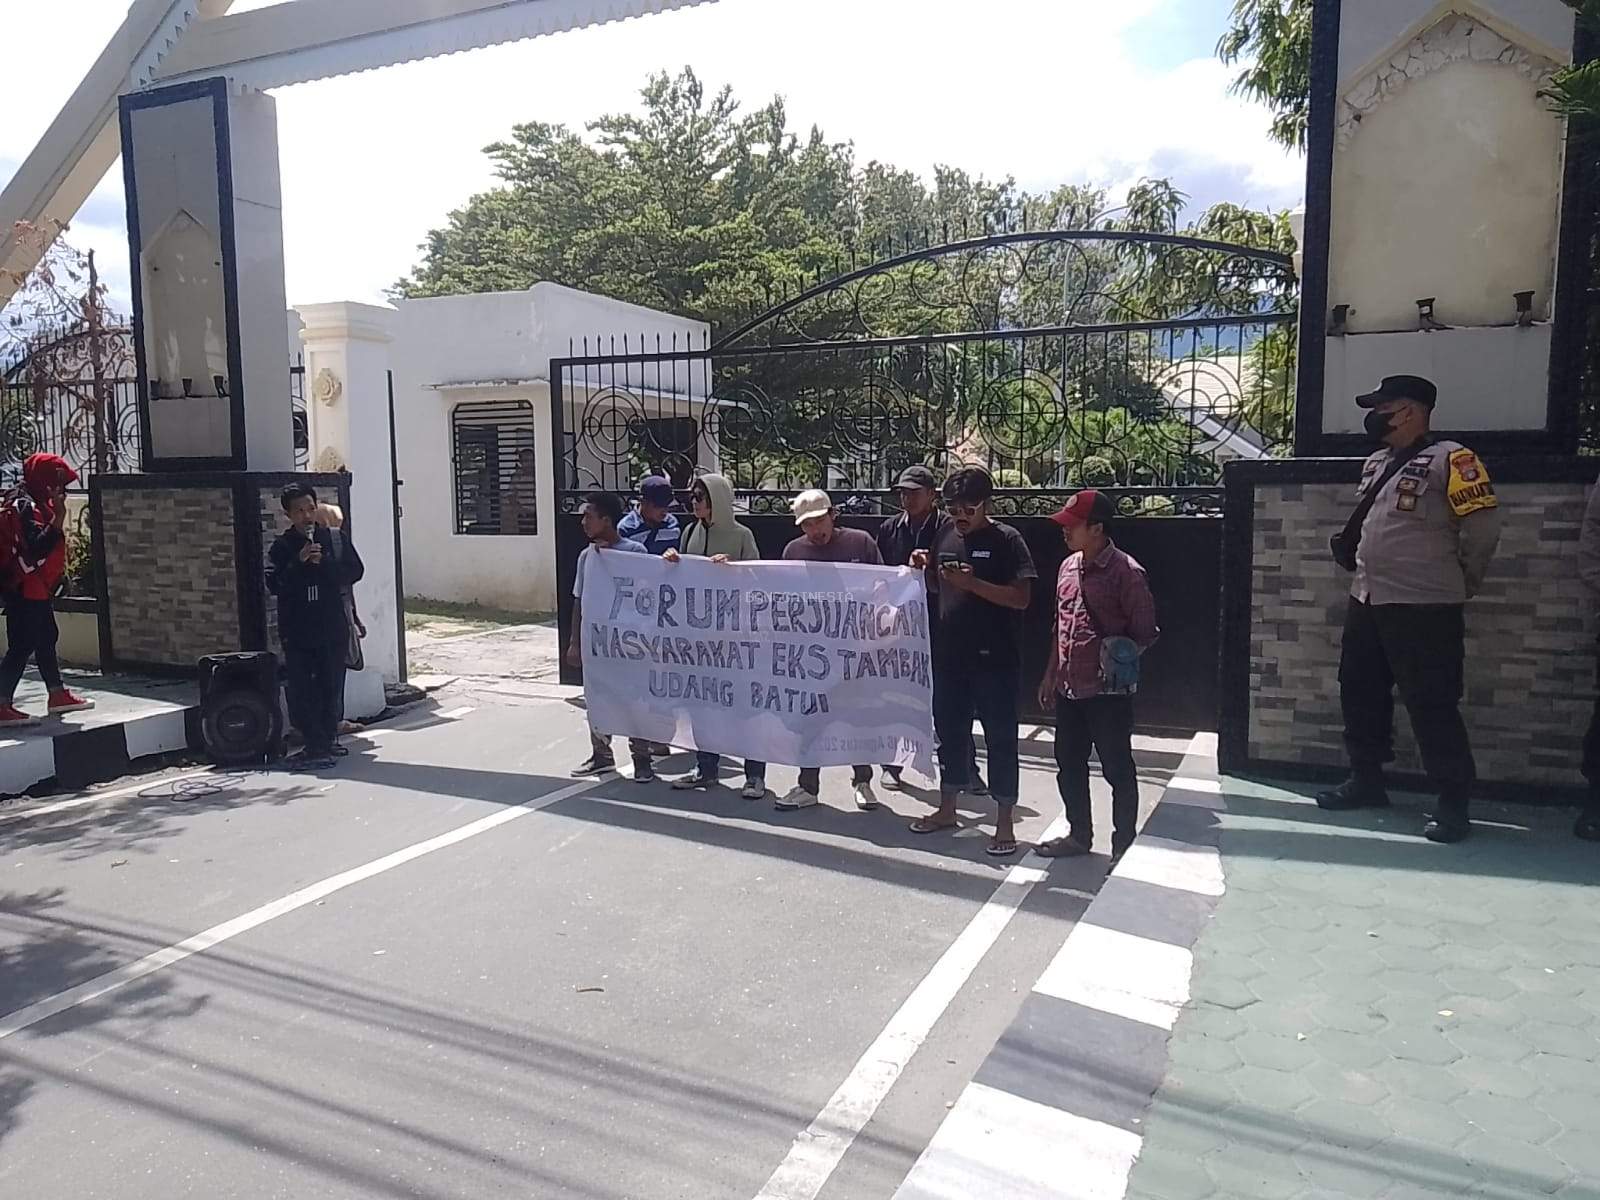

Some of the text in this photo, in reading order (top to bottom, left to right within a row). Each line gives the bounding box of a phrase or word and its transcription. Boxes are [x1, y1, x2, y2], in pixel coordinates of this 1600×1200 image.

[592, 623, 931, 688] MASYARAKAT EKS TAMBAK
[649, 670, 829, 716] UDANG BATUI
